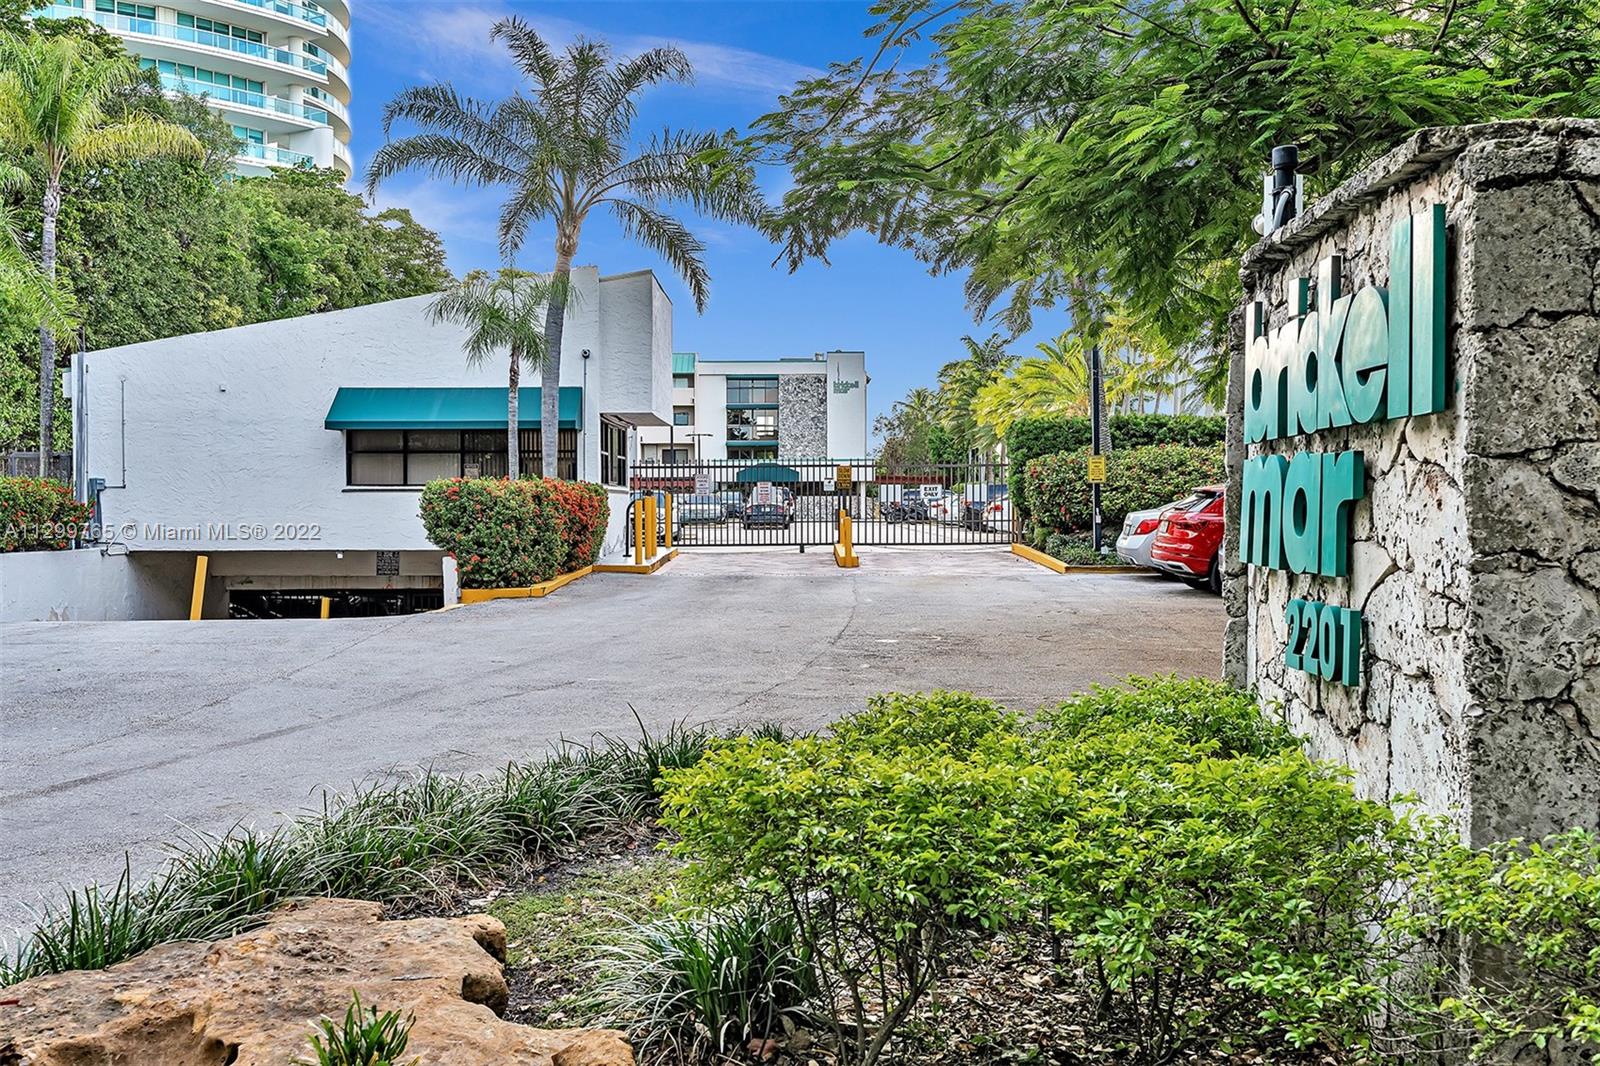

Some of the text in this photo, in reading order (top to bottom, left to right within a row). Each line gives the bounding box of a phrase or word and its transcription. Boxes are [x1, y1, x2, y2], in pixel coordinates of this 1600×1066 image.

[1244, 203, 1446, 445] brickell
[1239, 450, 1364, 578] mar
[1285, 598, 1362, 687] 2201
